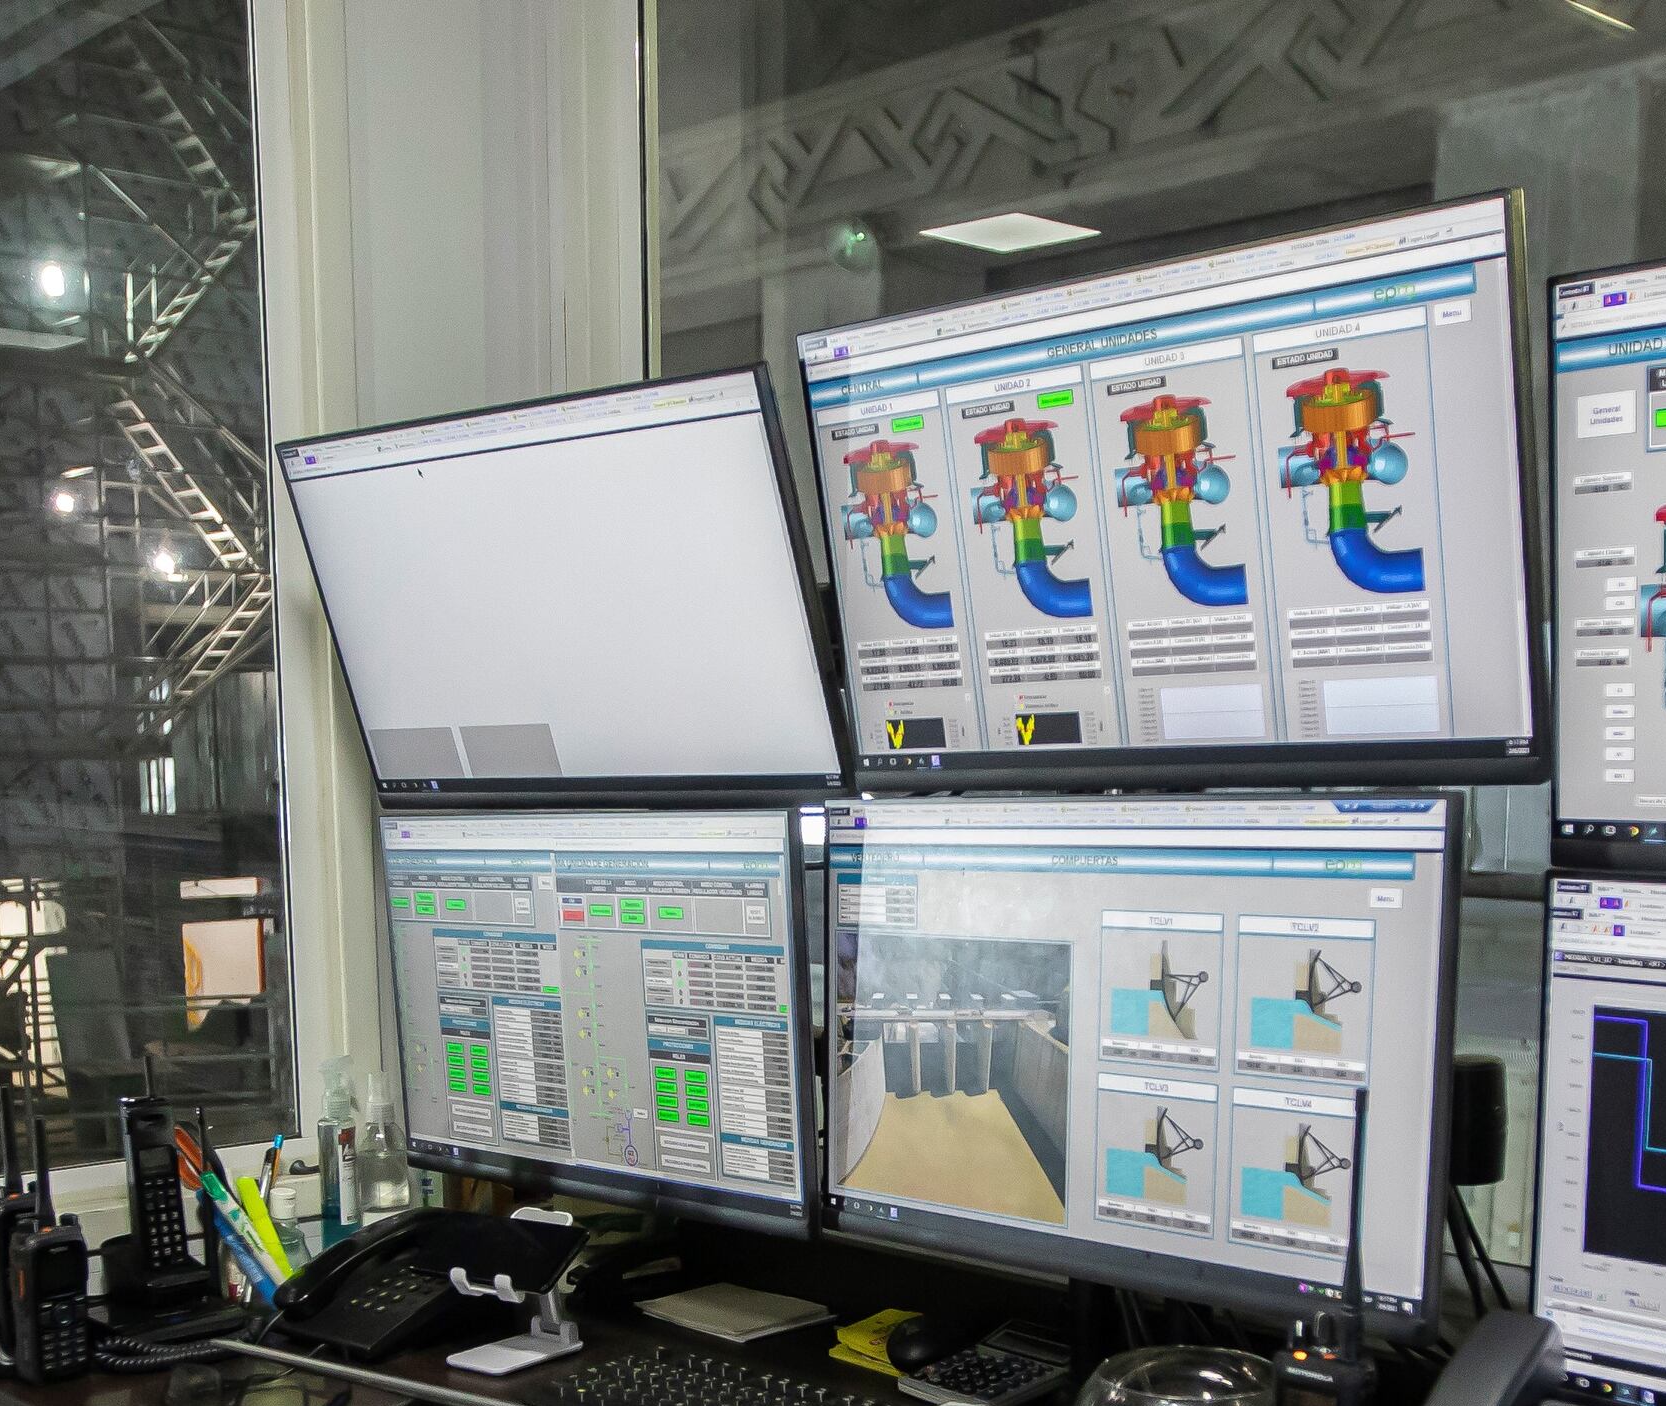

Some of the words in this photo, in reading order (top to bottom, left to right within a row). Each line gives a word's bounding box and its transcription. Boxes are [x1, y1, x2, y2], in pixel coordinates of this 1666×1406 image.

[1442, 308, 1462, 318] Menu
[1316, 327, 1352, 338] UNIDAD
[1046, 339, 1095, 358] GENERAL
[1101, 328, 1157, 347] UNIDADES
[1608, 338, 1664, 356] UNIDAD
[1144, 354, 1178, 366] UNIDAD
[1277, 354, 1305, 366] ESTADO
[1306, 349, 1333, 362] UNIDAD
[841, 379, 883, 396] CENTRAL
[994, 381, 1022, 392] UNIDAD
[1111, 382, 1136, 393] ESTADO
[1137, 378, 1161, 390] UNIDAD
[861, 404, 886, 416] UNIDAD
[965, 406, 987, 416] ESTADO
[988, 402, 1010, 413] UNIDAD
[1592, 404, 1621, 416] General
[1590, 415, 1623, 427] Unidades
[835, 428, 854, 438] ESTADO
[855, 425, 875, 436] UNIDAD
[1051, 855, 1118, 867] COMPUERTAS
